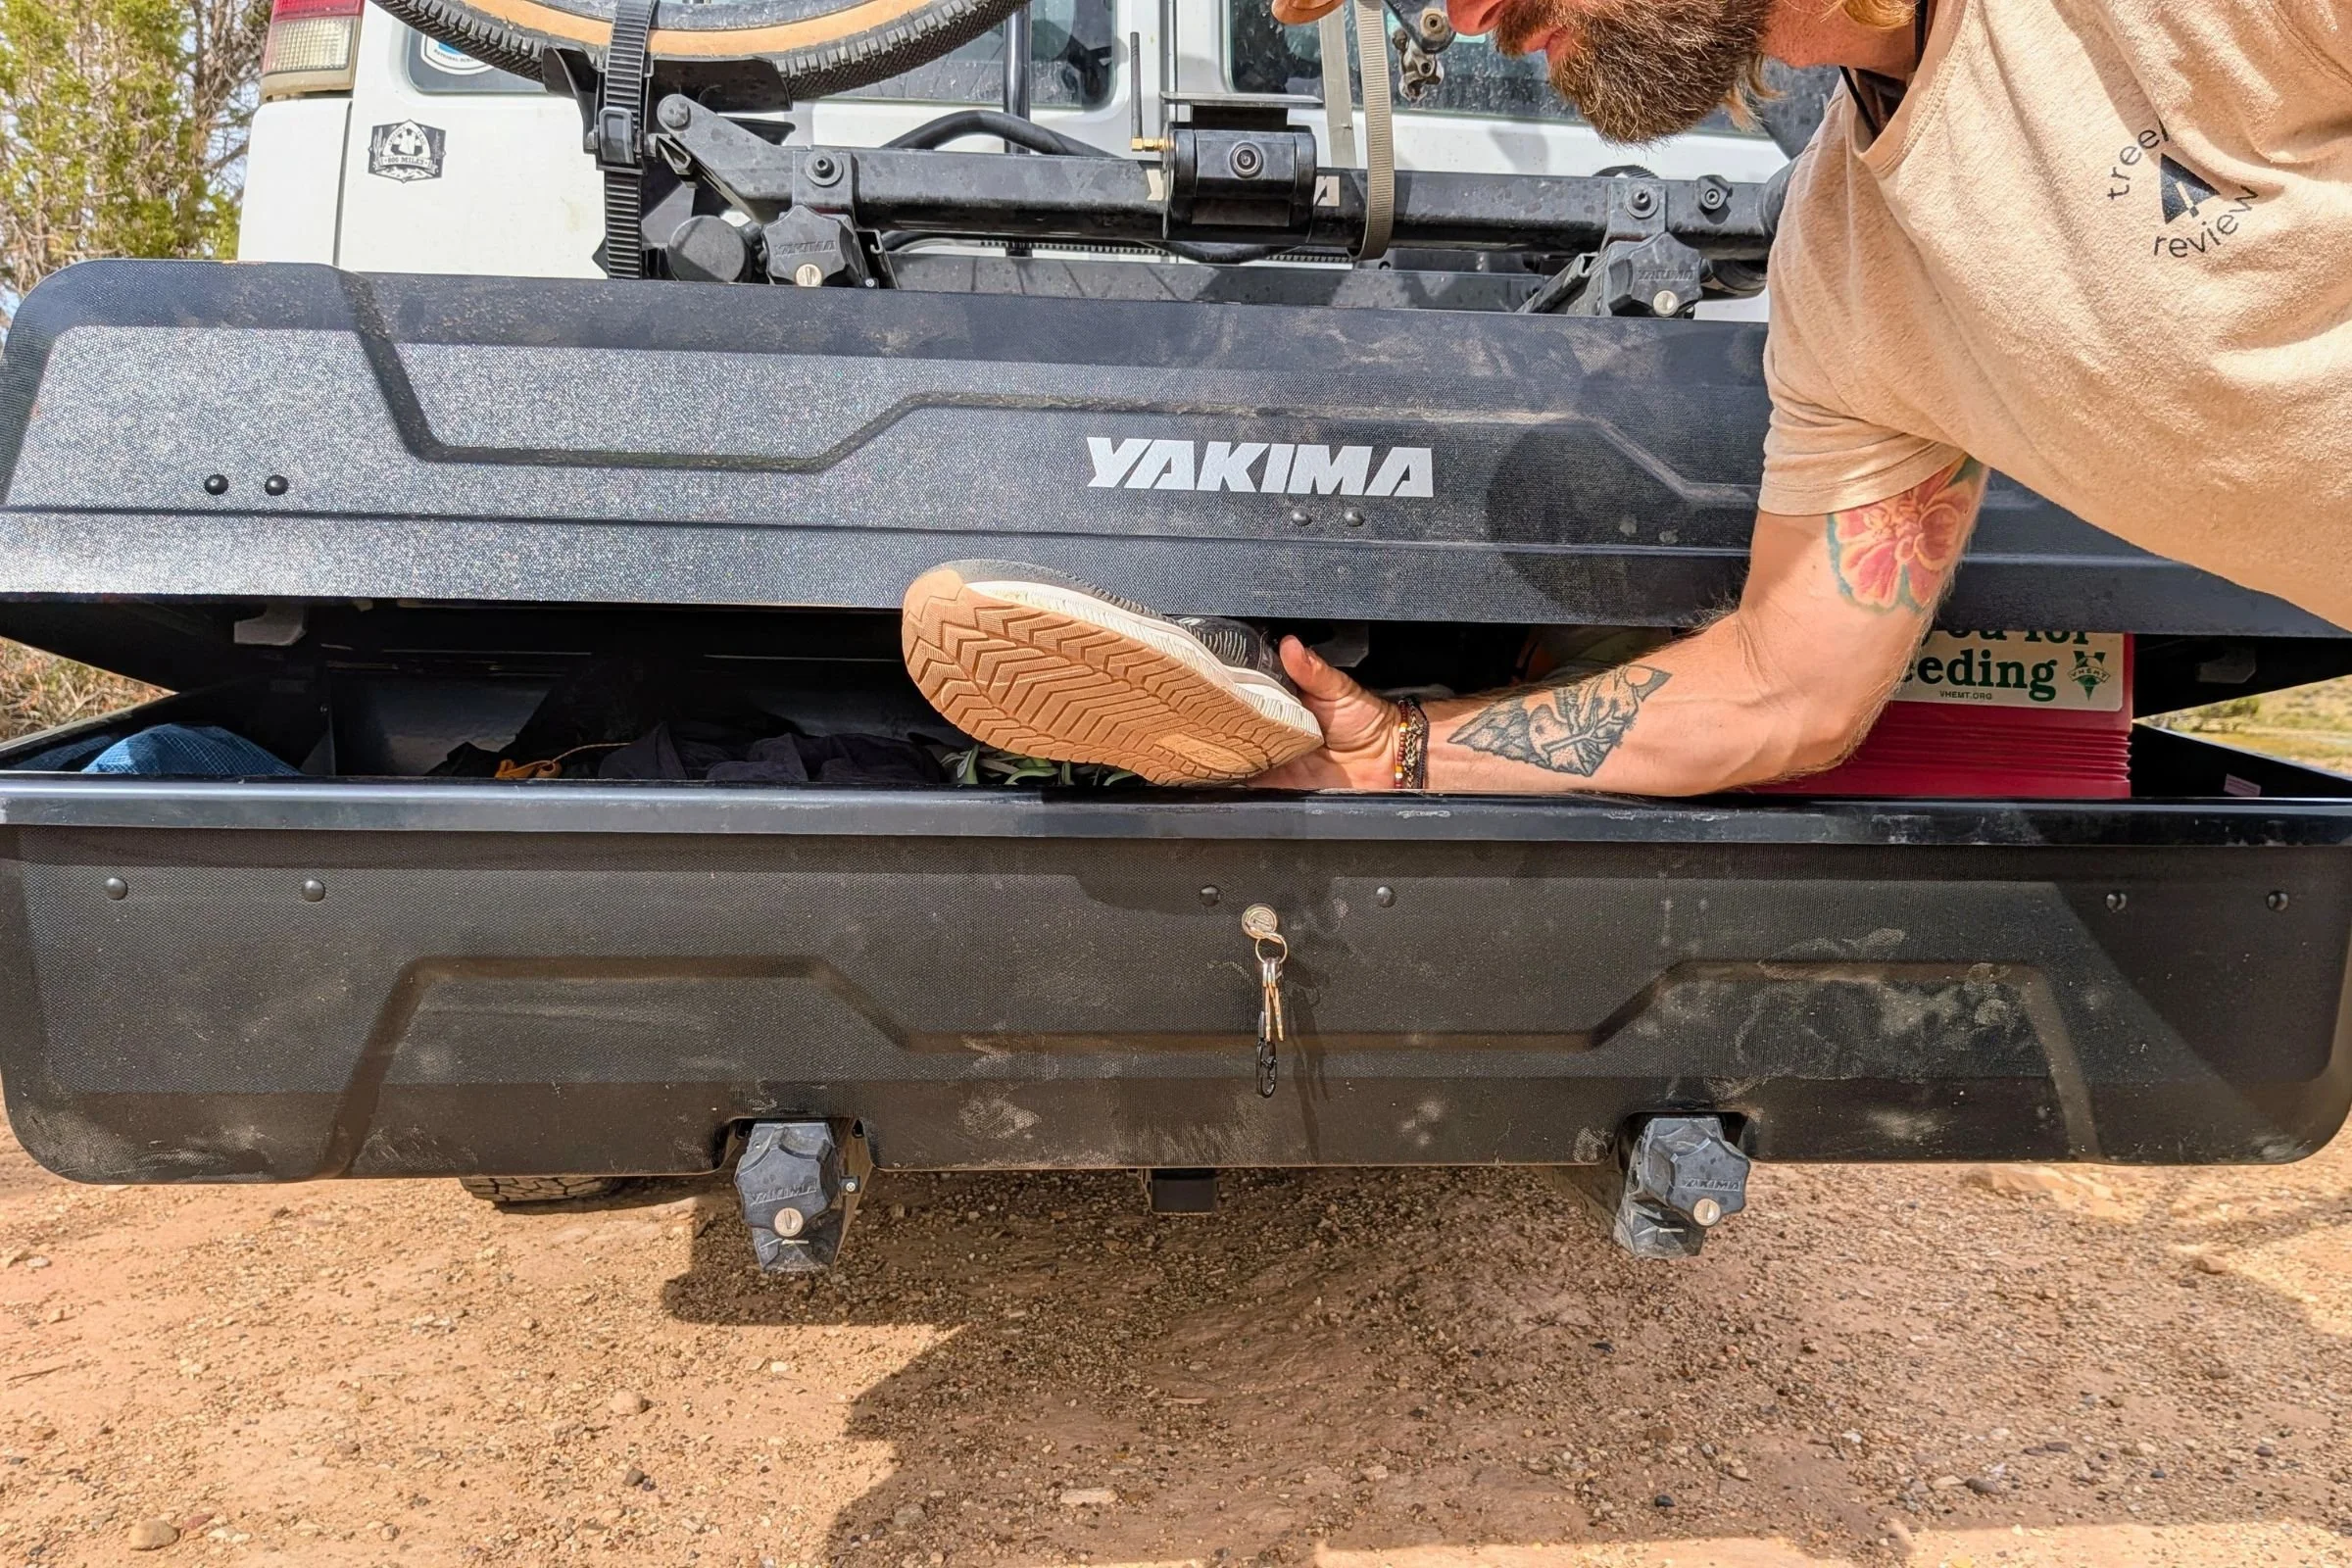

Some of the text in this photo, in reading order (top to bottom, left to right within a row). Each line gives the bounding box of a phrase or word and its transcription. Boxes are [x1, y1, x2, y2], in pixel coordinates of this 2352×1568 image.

[2153, 184, 2259, 258] review
[1087, 437, 1434, 497] YAKIMA
[1939, 690, 1992, 700] VHEMT.ORG
